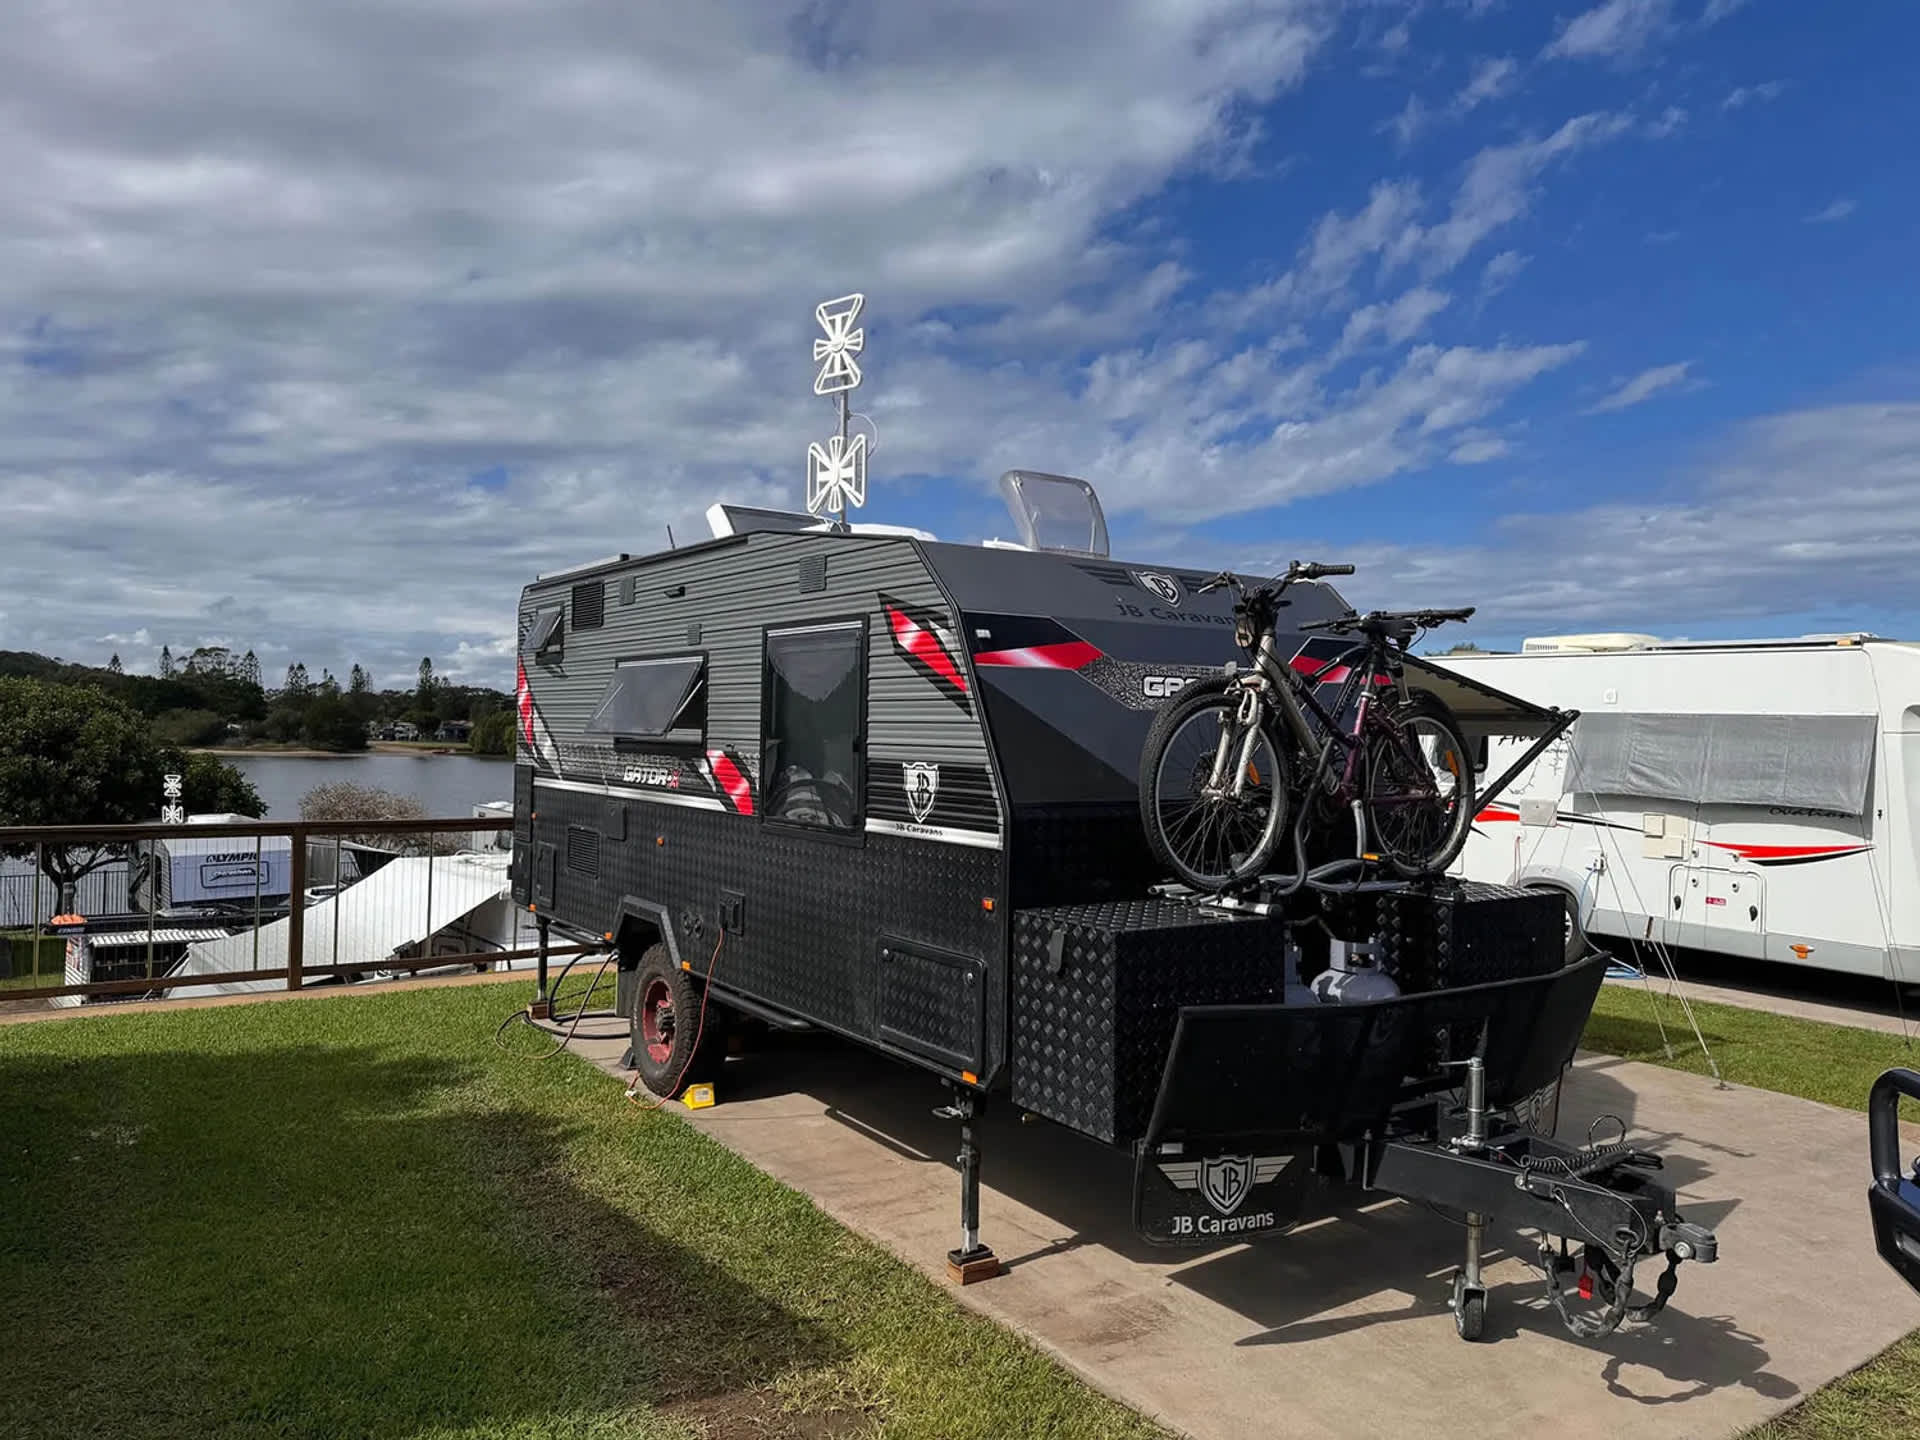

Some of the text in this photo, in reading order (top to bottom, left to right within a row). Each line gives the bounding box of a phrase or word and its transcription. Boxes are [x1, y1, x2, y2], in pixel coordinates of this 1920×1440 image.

[1150, 607, 1236, 625] Caravan
[906, 824, 943, 836] Caravans
[1171, 1212, 1274, 1234] JB Caravans
